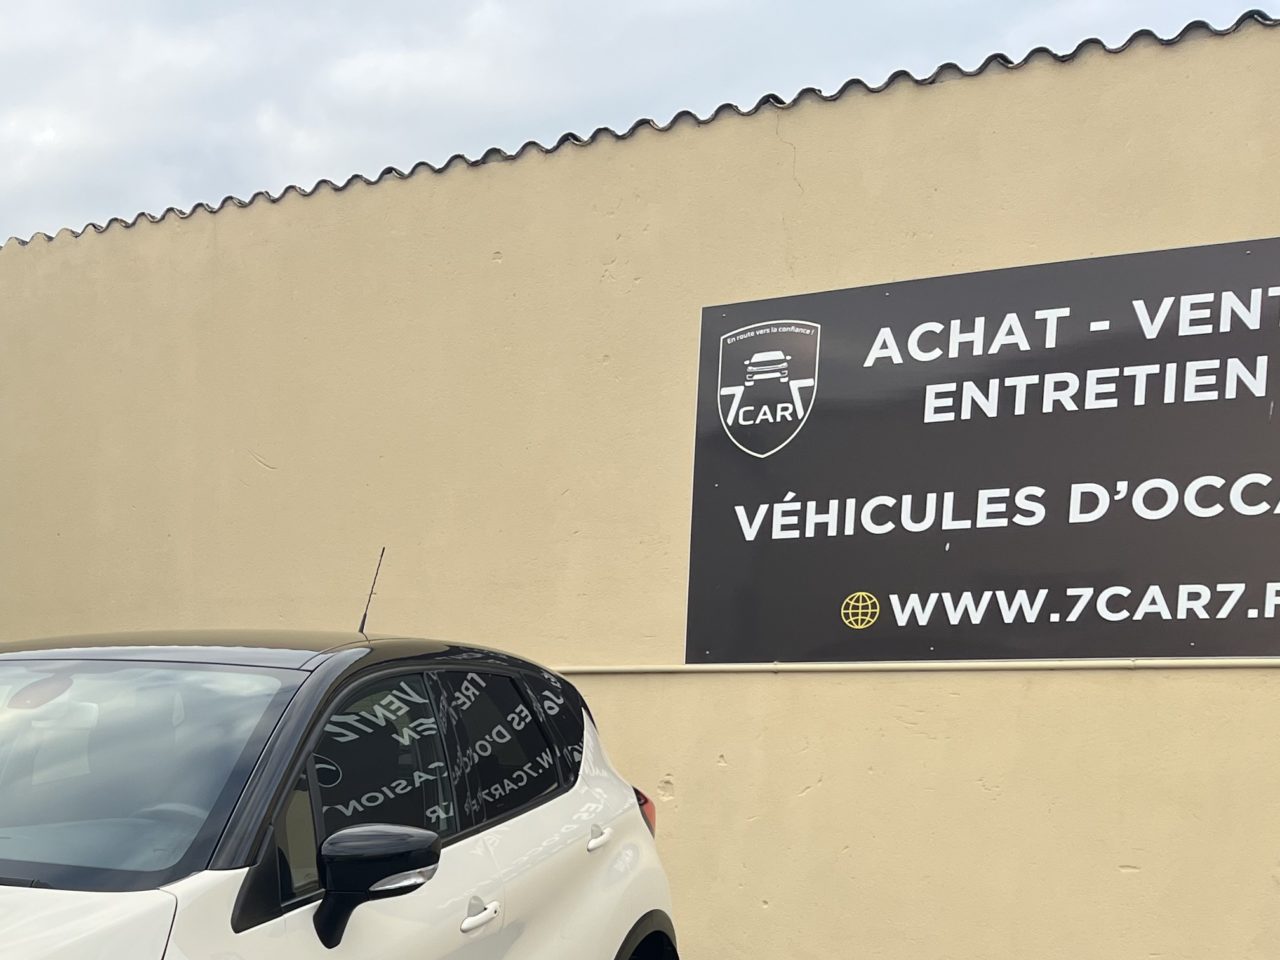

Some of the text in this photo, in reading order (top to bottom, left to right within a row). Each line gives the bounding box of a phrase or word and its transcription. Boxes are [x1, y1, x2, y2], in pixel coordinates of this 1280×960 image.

[736, 331, 755, 341] route
[756, 326, 770, 336] vers
[778, 326, 810, 335] confiance
[862, 307, 1071, 368] ACHAT
[923, 355, 1269, 424] ENTRETIEN
[734, 473, 1280, 542] VÉHICULES D'OCC
